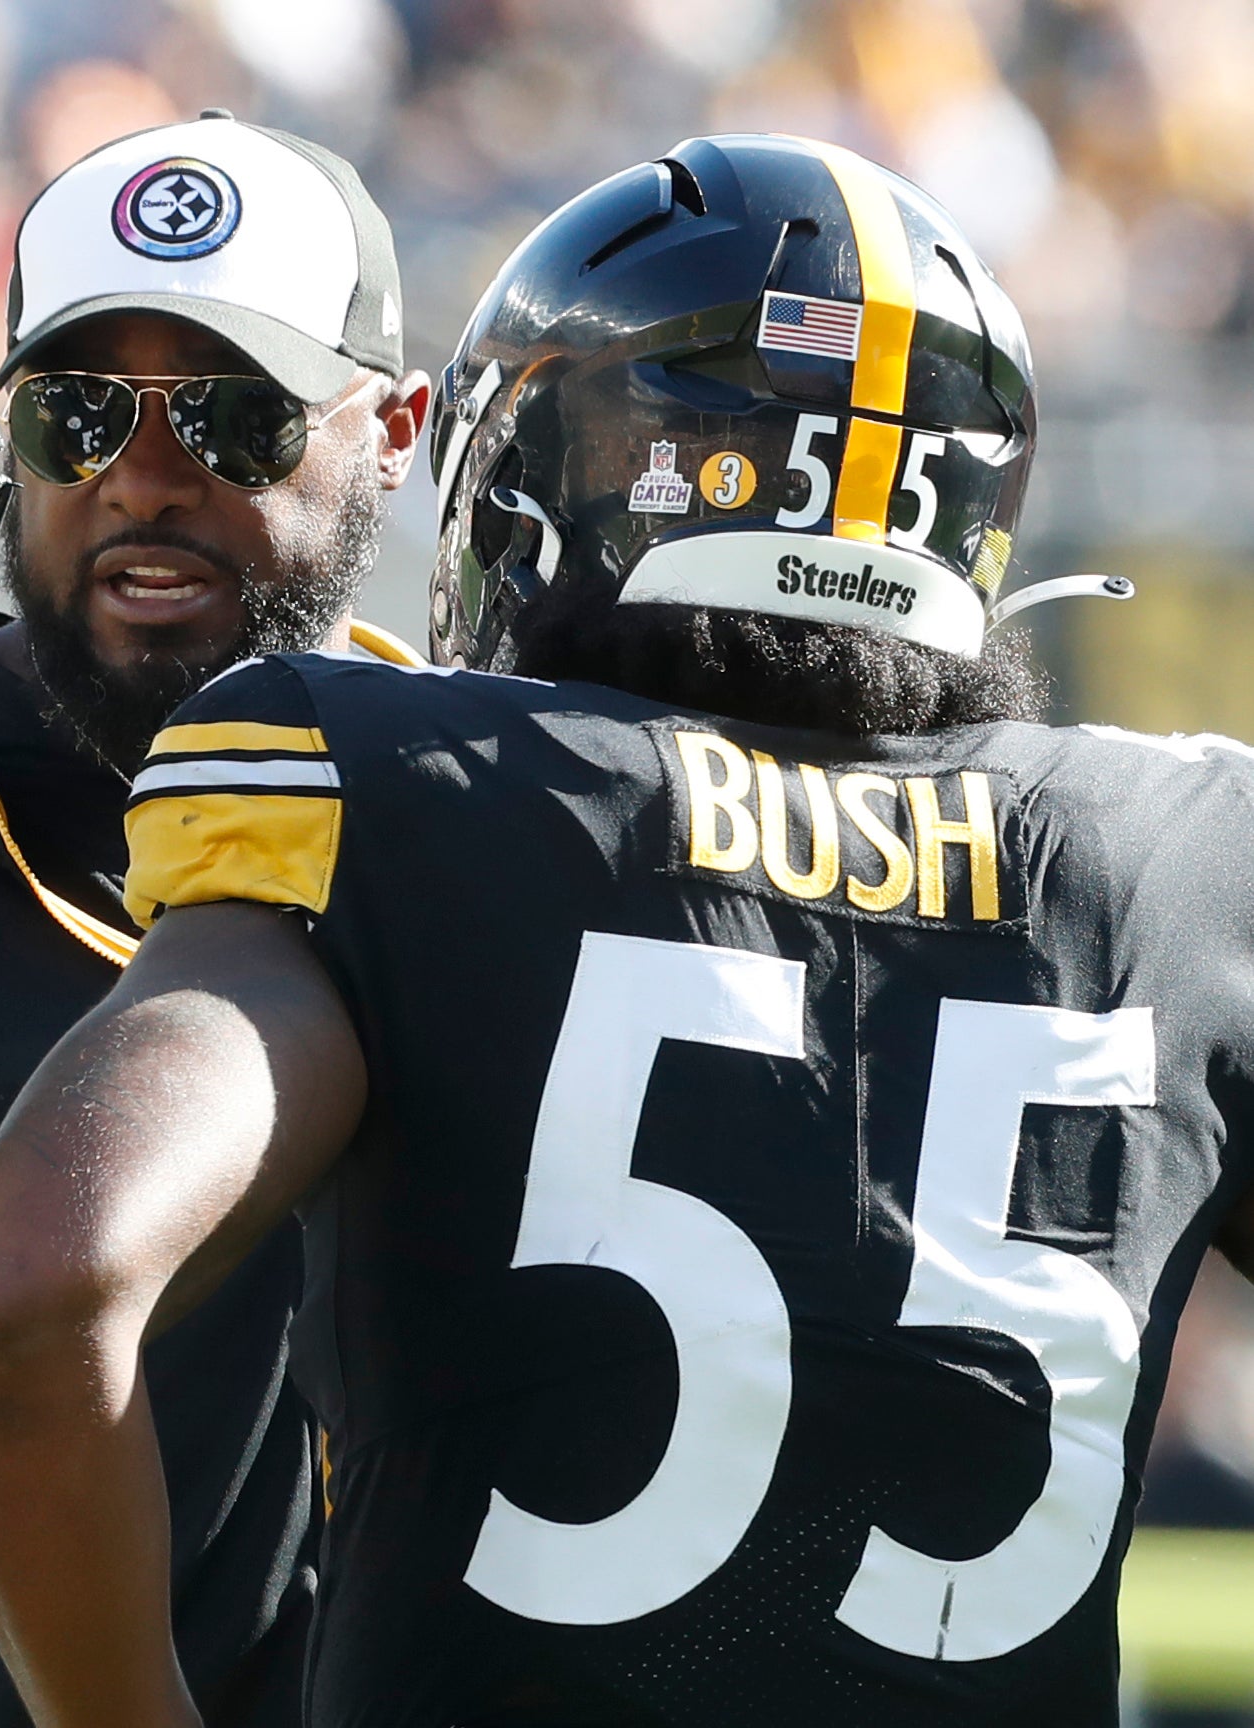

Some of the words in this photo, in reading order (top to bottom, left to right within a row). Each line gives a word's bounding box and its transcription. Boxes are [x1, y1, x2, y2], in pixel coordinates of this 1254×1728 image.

[642, 474, 683, 484] CRUCIAL
[655, 455, 671, 470] NFL
[713, 455, 742, 505] 3
[634, 484, 689, 503] CATCH
[777, 555, 916, 615] Steelers
[675, 731, 999, 920] BUSH
[463, 931, 1156, 1662] 55
